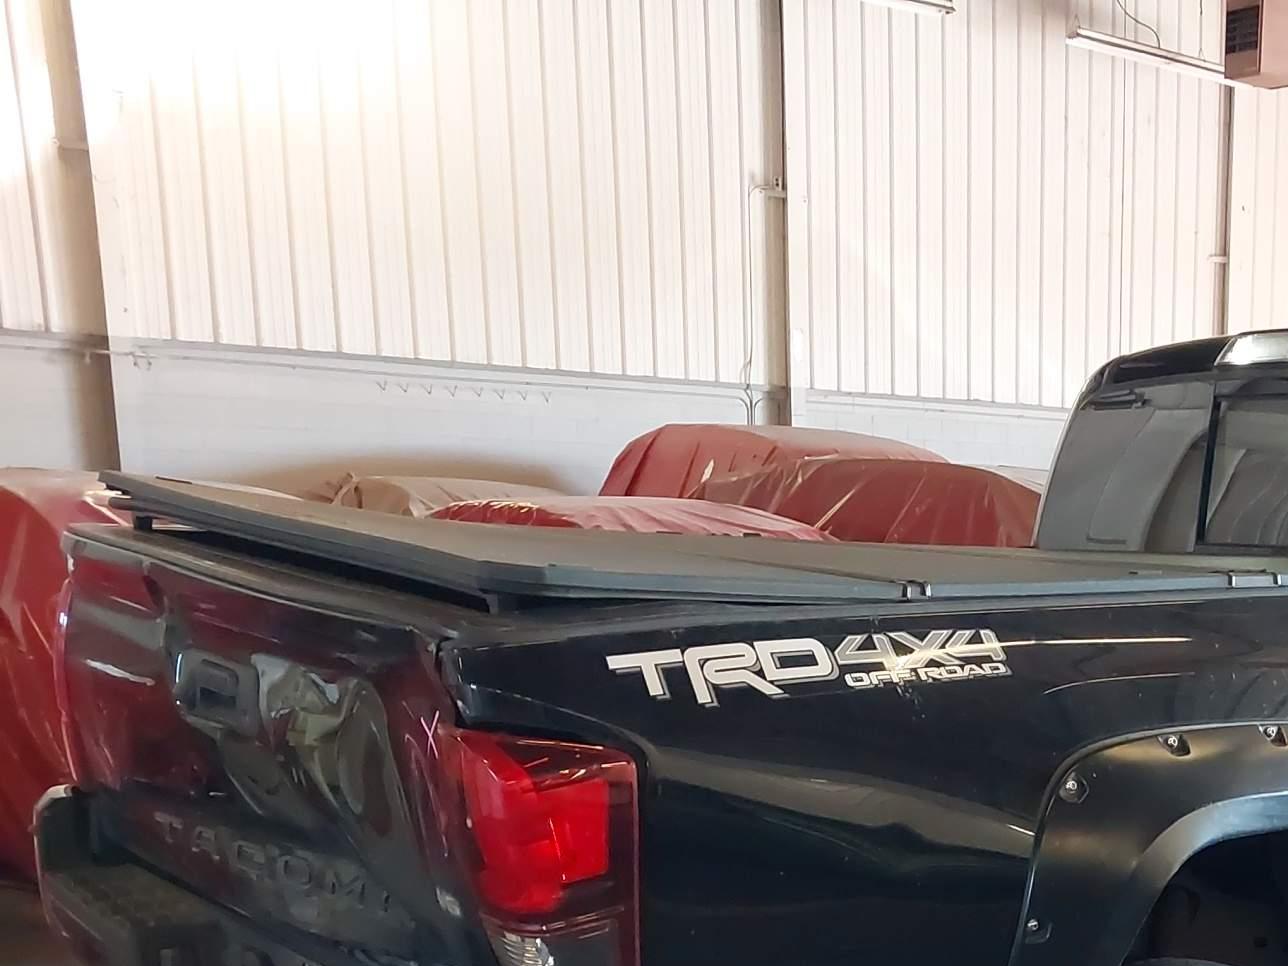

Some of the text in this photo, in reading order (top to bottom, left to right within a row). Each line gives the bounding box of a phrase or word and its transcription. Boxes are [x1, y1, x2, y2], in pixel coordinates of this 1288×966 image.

[606, 638, 839, 708] TRD
[844, 662, 1012, 689] OFF ROAD
